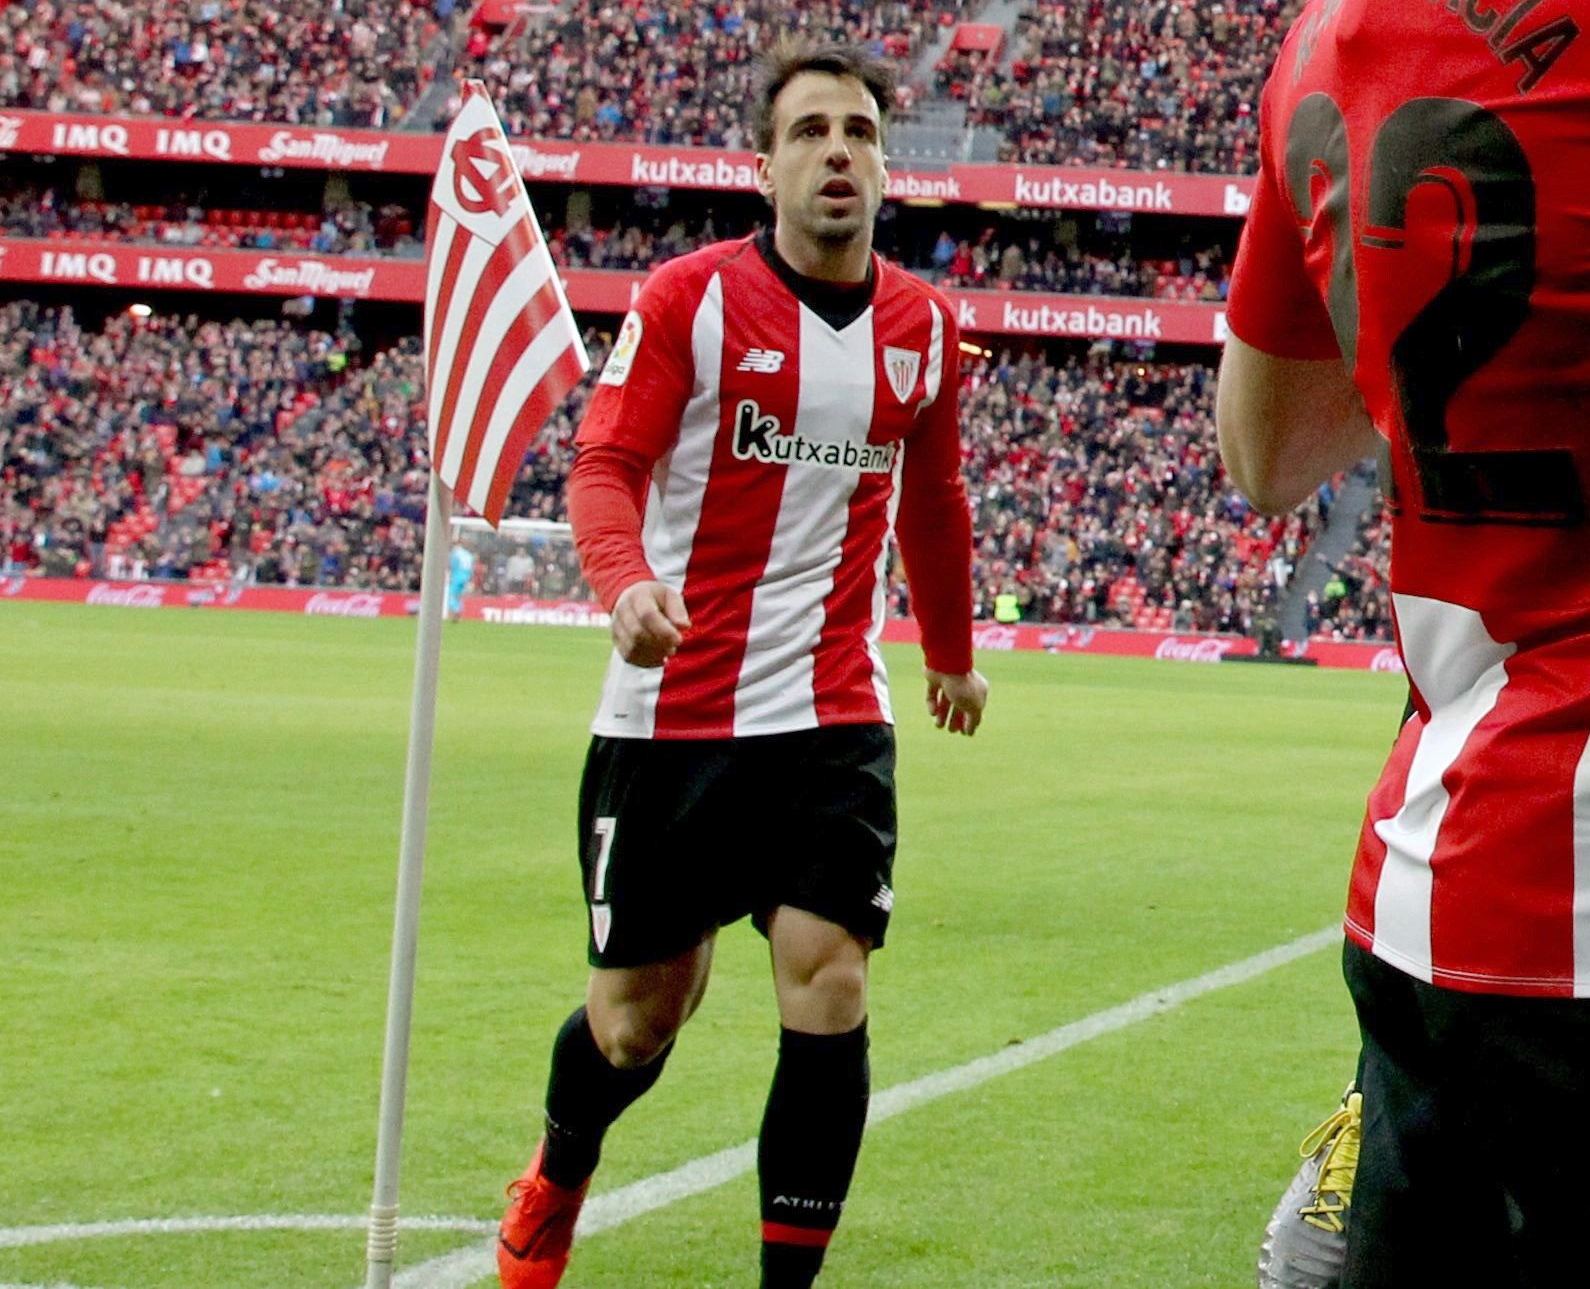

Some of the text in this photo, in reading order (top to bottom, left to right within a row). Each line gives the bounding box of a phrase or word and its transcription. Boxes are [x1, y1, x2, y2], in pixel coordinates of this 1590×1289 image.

[53, 123, 129, 155] IMQ
[156, 128, 232, 160] IMQ
[1014, 173, 1172, 210] kutxabank
[40, 252, 117, 284] IMQ
[138, 257, 214, 289] IMQ
[1003, 301, 1162, 338] kutxabank
[594, 817, 617, 900] 7
